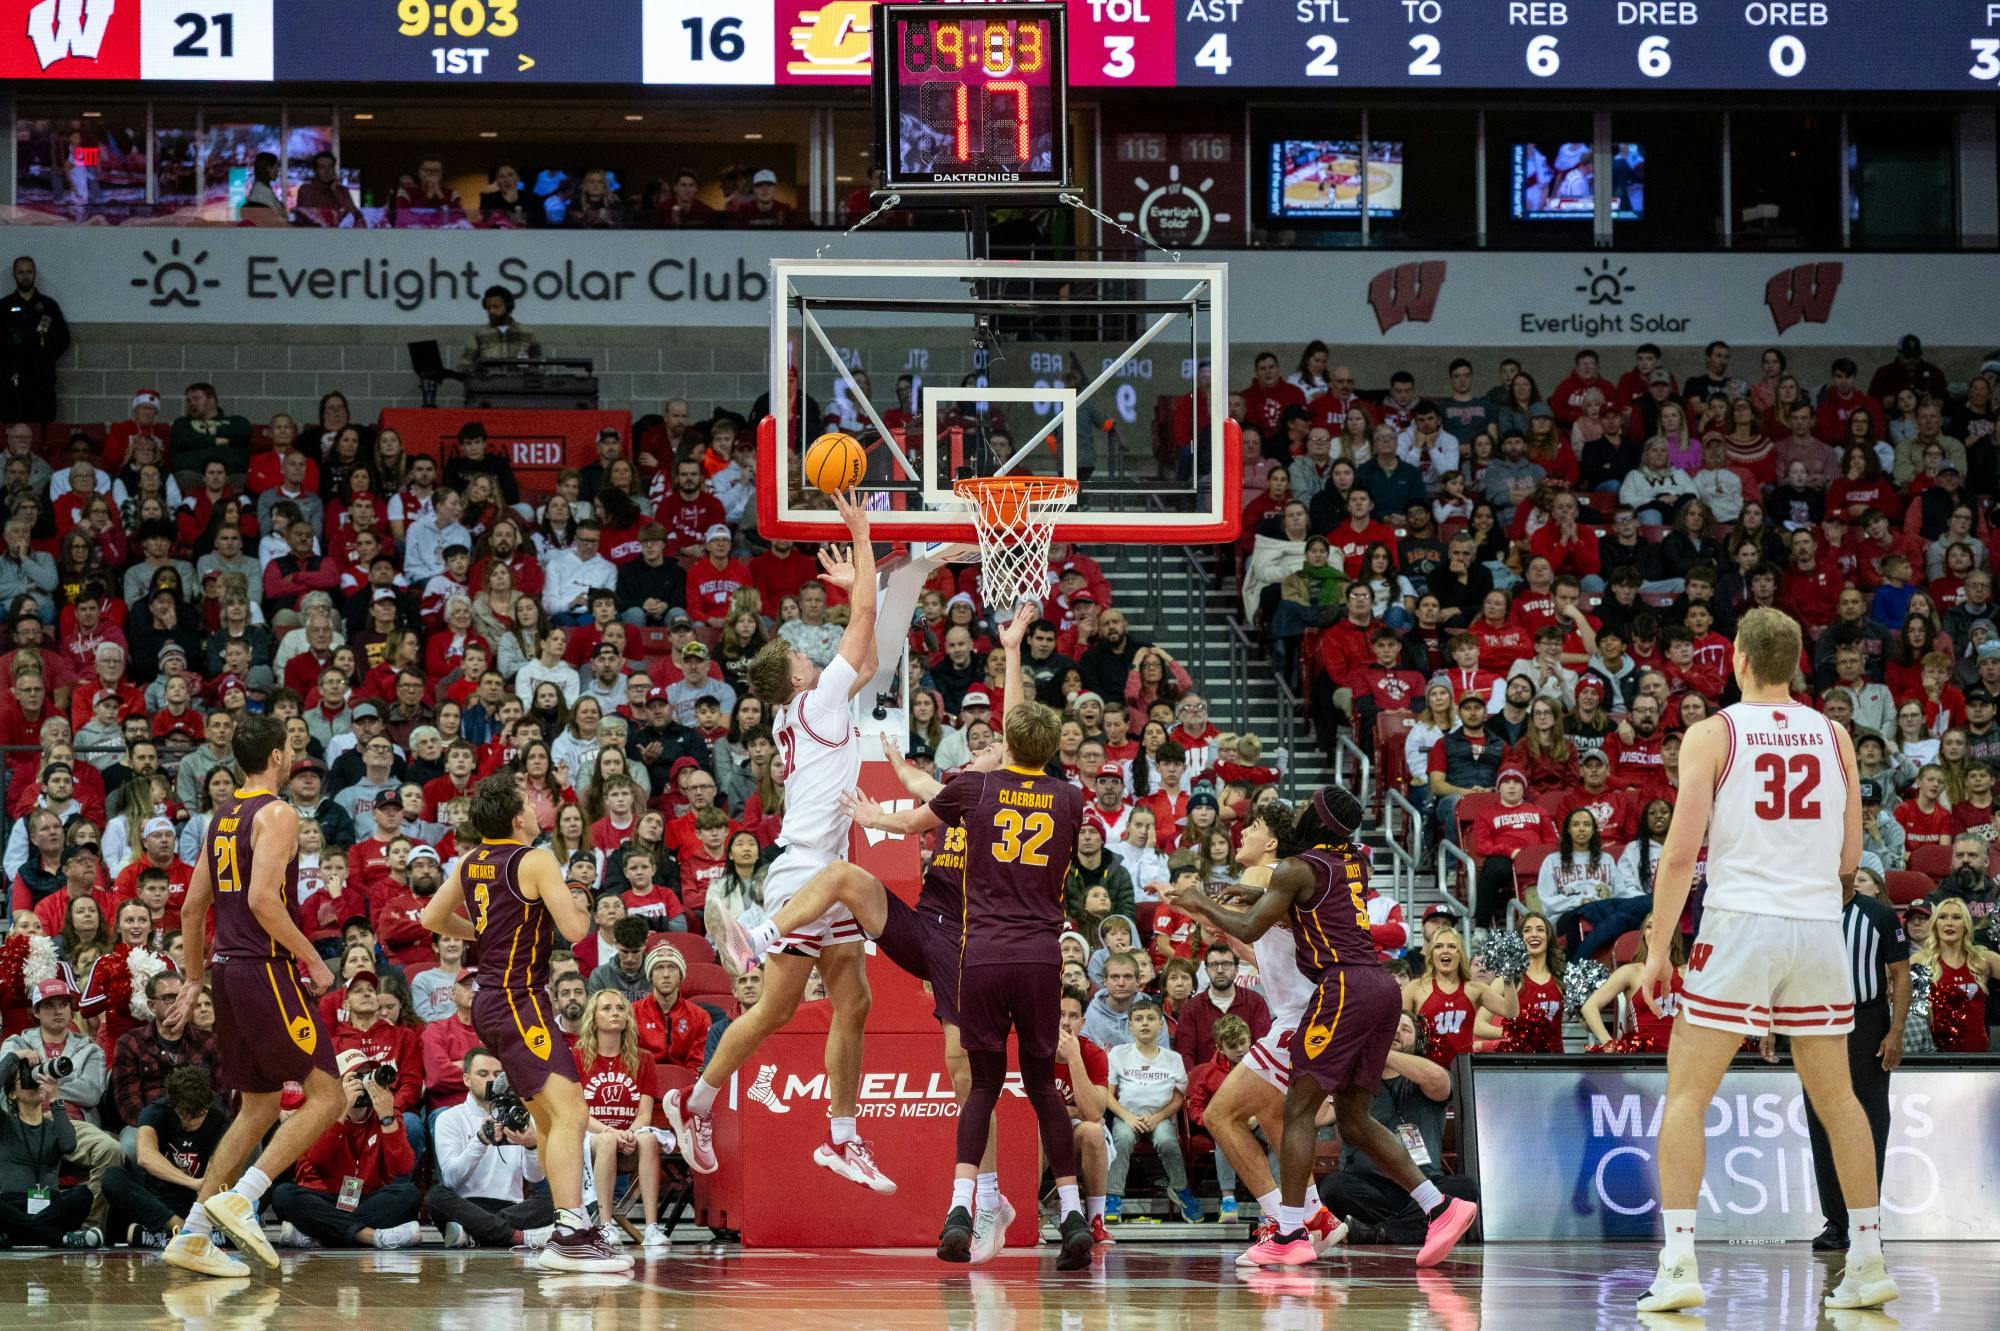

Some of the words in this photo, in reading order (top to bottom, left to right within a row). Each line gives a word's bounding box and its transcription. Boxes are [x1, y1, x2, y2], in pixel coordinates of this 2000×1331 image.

[398, 0, 519, 37] 9:03
[1087, 0, 1150, 22] TOL
[1187, 0, 1243, 23] AST
[1297, 1, 1350, 23] STL
[1406, 1, 1442, 23] TO
[1509, 2, 1568, 25] REB
[1617, 2, 1698, 25] DREB
[1745, 2, 1828, 26] OREB
[1987, 4, 2000, 26] F
[173, 13, 234, 57] 21
[681, 16, 746, 62] 16
[936, 24, 1042, 72] 9:03
[1102, 35, 1135, 78] 3
[1194, 33, 1232, 75] 4
[1305, 34, 1339, 76] 2
[1408, 33, 1442, 76] 2
[1526, 35, 1560, 77] 6
[1637, 35, 1672, 77] 6
[1768, 35, 1807, 77] 0
[431, 48, 490, 74] 1ST
[956, 81, 1030, 162] 17
[1125, 141, 1159, 158] 115
[1189, 140, 1223, 158] 116
[933, 172, 1020, 182] DAKTRONICS
[1150, 206, 1200, 221] Everlight
[1159, 217, 1190, 229] Solar
[247, 256, 482, 311] Everlight
[499, 257, 636, 301] Solar
[648, 257, 769, 301] Club
[1520, 313, 1622, 338] Everlight
[1630, 313, 1691, 333] Solar
[512, 443, 562, 465] RED
[1746, 733, 1824, 747] BIELIAUSKAS
[999, 789, 1054, 809] CLAERBAUT
[1754, 752, 1822, 821] 32
[1493, 812, 1540, 830] WISCONSIN
[943, 827, 966, 852] 33
[992, 808, 1055, 867] 32
[213, 835, 242, 893] 21
[933, 854, 965, 870] ICHIGA
[474, 883, 490, 935] 3
[1348, 881, 1370, 930] 5
[1123, 1067, 1170, 1079] WISCONSIN
[584, 1072, 640, 1101] WISCONSIN
[783, 1073, 1036, 1101] MELLR
[589, 1106, 638, 1116] ASKETBAL
